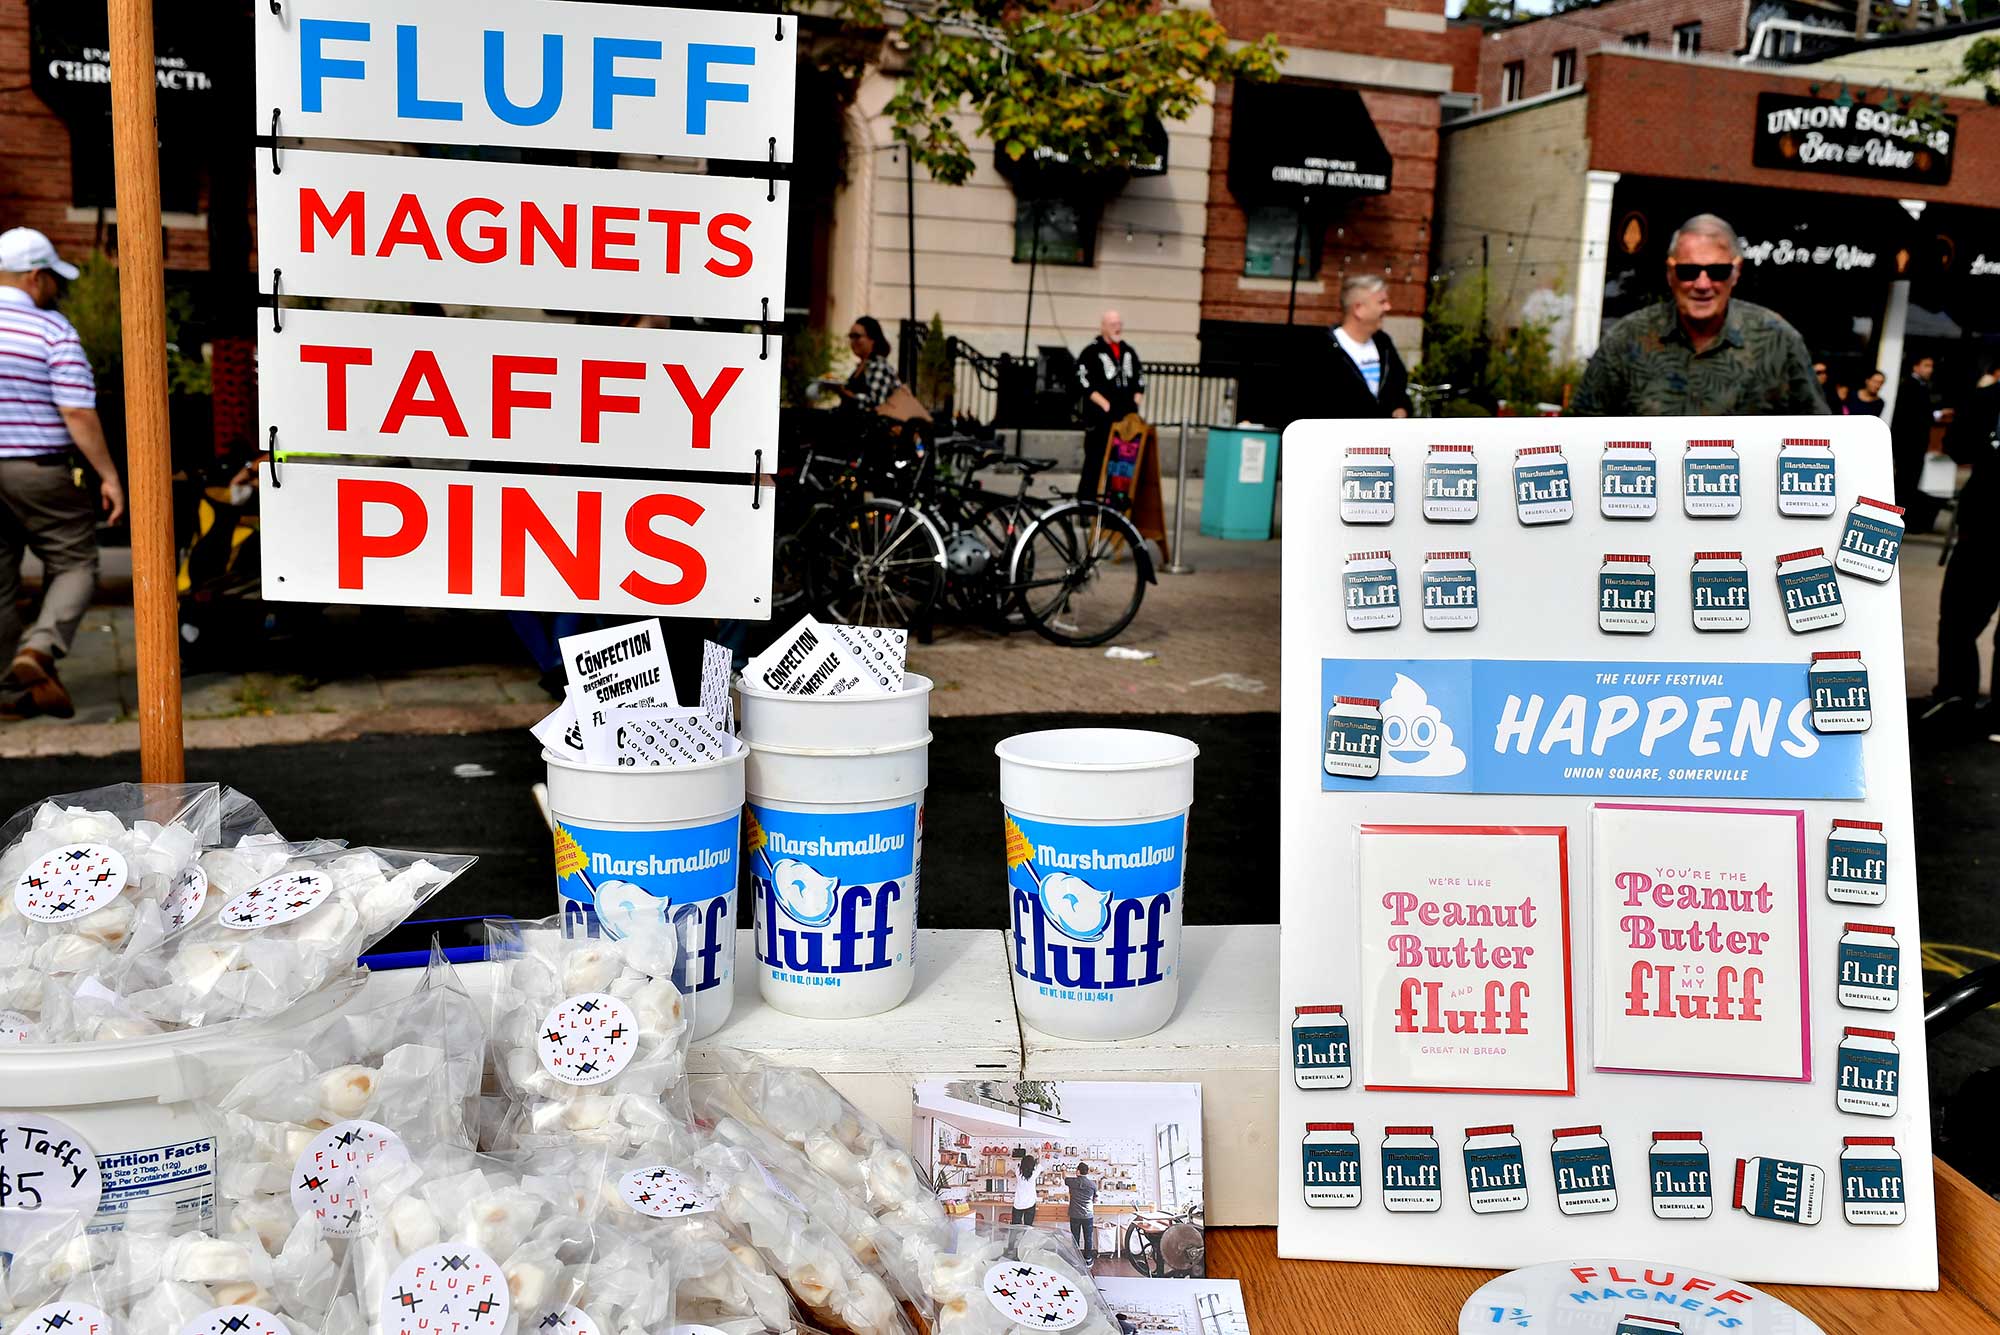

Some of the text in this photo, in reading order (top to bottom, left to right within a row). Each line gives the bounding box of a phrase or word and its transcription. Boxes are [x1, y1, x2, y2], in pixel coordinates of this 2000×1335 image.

[300, 18, 756, 135] FLUFF
[1767, 106, 1849, 134] UNION
[1865, 138, 1915, 168] Wine
[300, 188, 754, 278] MAGNETS
[300, 345, 744, 449] TAFFY
[1344, 480, 1393, 500] fluff
[1425, 478, 1476, 498] fluff
[1518, 479, 1568, 501] fluff
[1603, 474, 1656, 494] fluff
[1686, 474, 1739, 494] fluff
[1781, 472, 1834, 493] fluff
[337, 479, 708, 605] PINS
[1843, 529, 1899, 560] fluff
[1347, 585, 1397, 607] fluff
[1425, 585, 1476, 606] fluff
[1601, 588, 1653, 609] fluff
[1695, 587, 1747, 607] fluff
[1786, 582, 1837, 610] fluff
[576, 630, 651, 676] CONFECTION
[763, 627, 819, 691] CONFECTION
[798, 652, 841, 696] OMERVILLE
[862, 655, 881, 677] LOYAL
[583, 673, 613, 693] BASEMENT
[596, 667, 660, 703] SOMERVILLE
[846, 677, 860, 690] 2018
[1596, 673, 1724, 686] THE FLUFF FESTIVAL
[1814, 687, 1868, 709] fluff
[674, 723, 695, 744] LOYAL
[697, 725, 722, 749] SUPPLY
[1494, 694, 1820, 759] HAPPENS
[627, 739, 649, 761] LOYAL
[655, 744, 677, 765] LOYAL
[1328, 732, 1380, 755] fluff
[1563, 767, 1748, 781] UNION SQUARE, SOMERVILLE
[768, 829, 905, 856] Marshmallow
[43, 858, 109, 875] FLUFF
[591, 846, 731, 877] Marshmallow
[1038, 844, 1175, 870] Marshmallow
[1830, 857, 1885, 880] fluff
[1428, 877, 1491, 887] WE'RE LIKE
[1656, 867, 1747, 882] YOU'RE THE
[1615, 872, 1773, 913] Peanut
[1382, 892, 1536, 928] Peanut
[1013, 888, 1171, 990] fluff
[1620, 915, 1769, 955] Butter
[1388, 934, 1534, 969] Butter
[1683, 965, 1705, 974] TO
[1842, 961, 1897, 986] fluff
[1451, 986, 1473, 998] AND
[1625, 960, 1764, 1021] fluff
[1682, 979, 1705, 988] MY
[1097, 992, 1108, 1001] 454
[1394, 977, 1529, 1034] fluff
[559, 1011, 618, 1028] FLUFF
[1296, 1042, 1348, 1065] fluff
[1421, 1046, 1454, 1055] GREAT
[1474, 1047, 1507, 1055] BREAD
[1841, 1066, 1896, 1092] fluff
[18, 1126, 88, 1188] Taffy
[98, 1142, 211, 1169] utrition Facts
[114, 1170, 130, 1178] Size
[162, 1161, 181, 1171] (12g)
[134, 1173, 170, 1183] Container
[172, 1167, 192, 1176] about
[1306, 1161, 1358, 1183] fluff
[1385, 1165, 1438, 1187] fluff
[1470, 1163, 1522, 1189] fluff
[1558, 1164, 1610, 1191] fluff
[1655, 1171, 1708, 1193] fluff
[1773, 1163, 1799, 1219] fluff
[1846, 1176, 1901, 1199] fluff
[416, 1267, 492, 1295] FLUFF
[1570, 1266, 1753, 1305] FLUFF
[1569, 1287, 1744, 1329] MAGNETS
